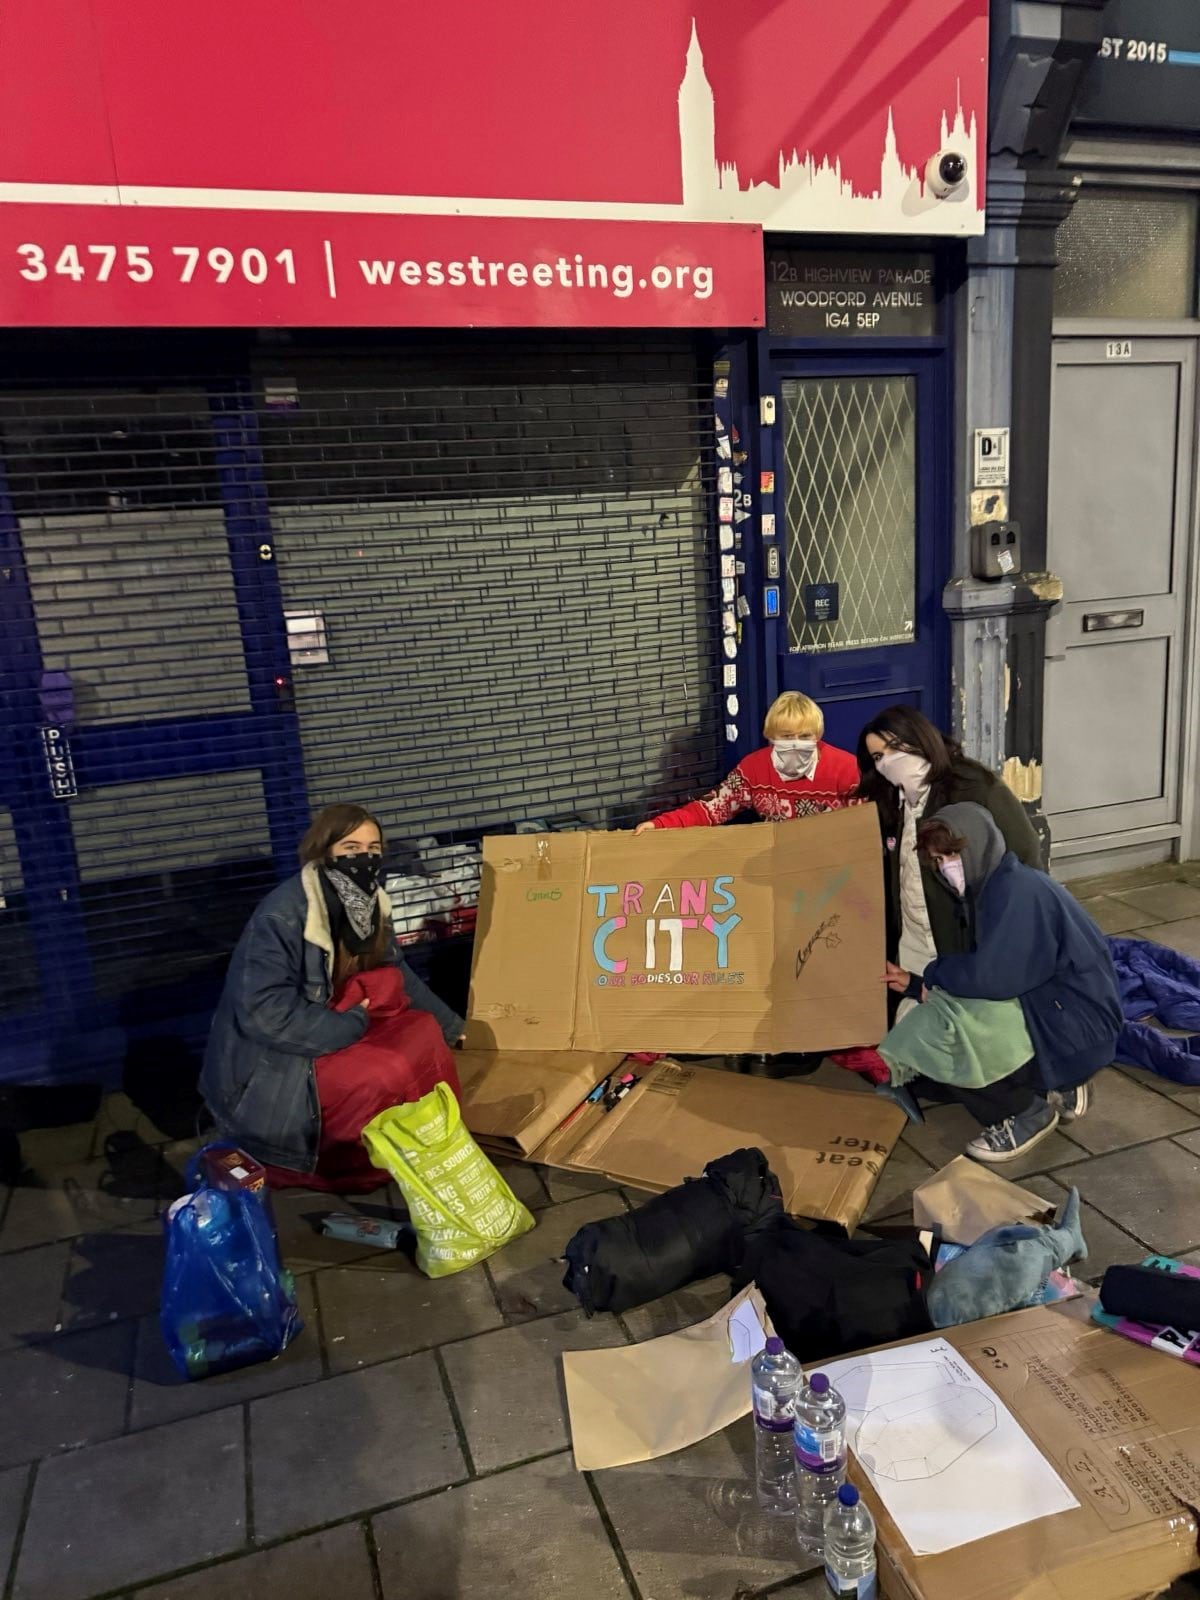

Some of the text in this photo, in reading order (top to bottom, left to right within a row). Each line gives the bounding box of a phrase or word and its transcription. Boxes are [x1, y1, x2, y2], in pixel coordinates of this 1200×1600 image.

[1098, 37, 1167, 64] ST 2015
[18, 243, 713, 299] 3475 7901 wesstreeting.org
[770, 261, 931, 284] 12B HIGHVIEW PARADE
[781, 290, 923, 307] WOODFORD AVENUE
[825, 312, 880, 328] IG4 5EP
[1107, 342, 1130, 356] 13A
[814, 598, 831, 607] REC
[587, 876, 737, 918] TRANS
[592, 913, 743, 974] CITY
[702, 971, 745, 985] RULES
[815, 1151, 880, 1177] seat
[1115, 1460, 1161, 1515] CUSTOMER
